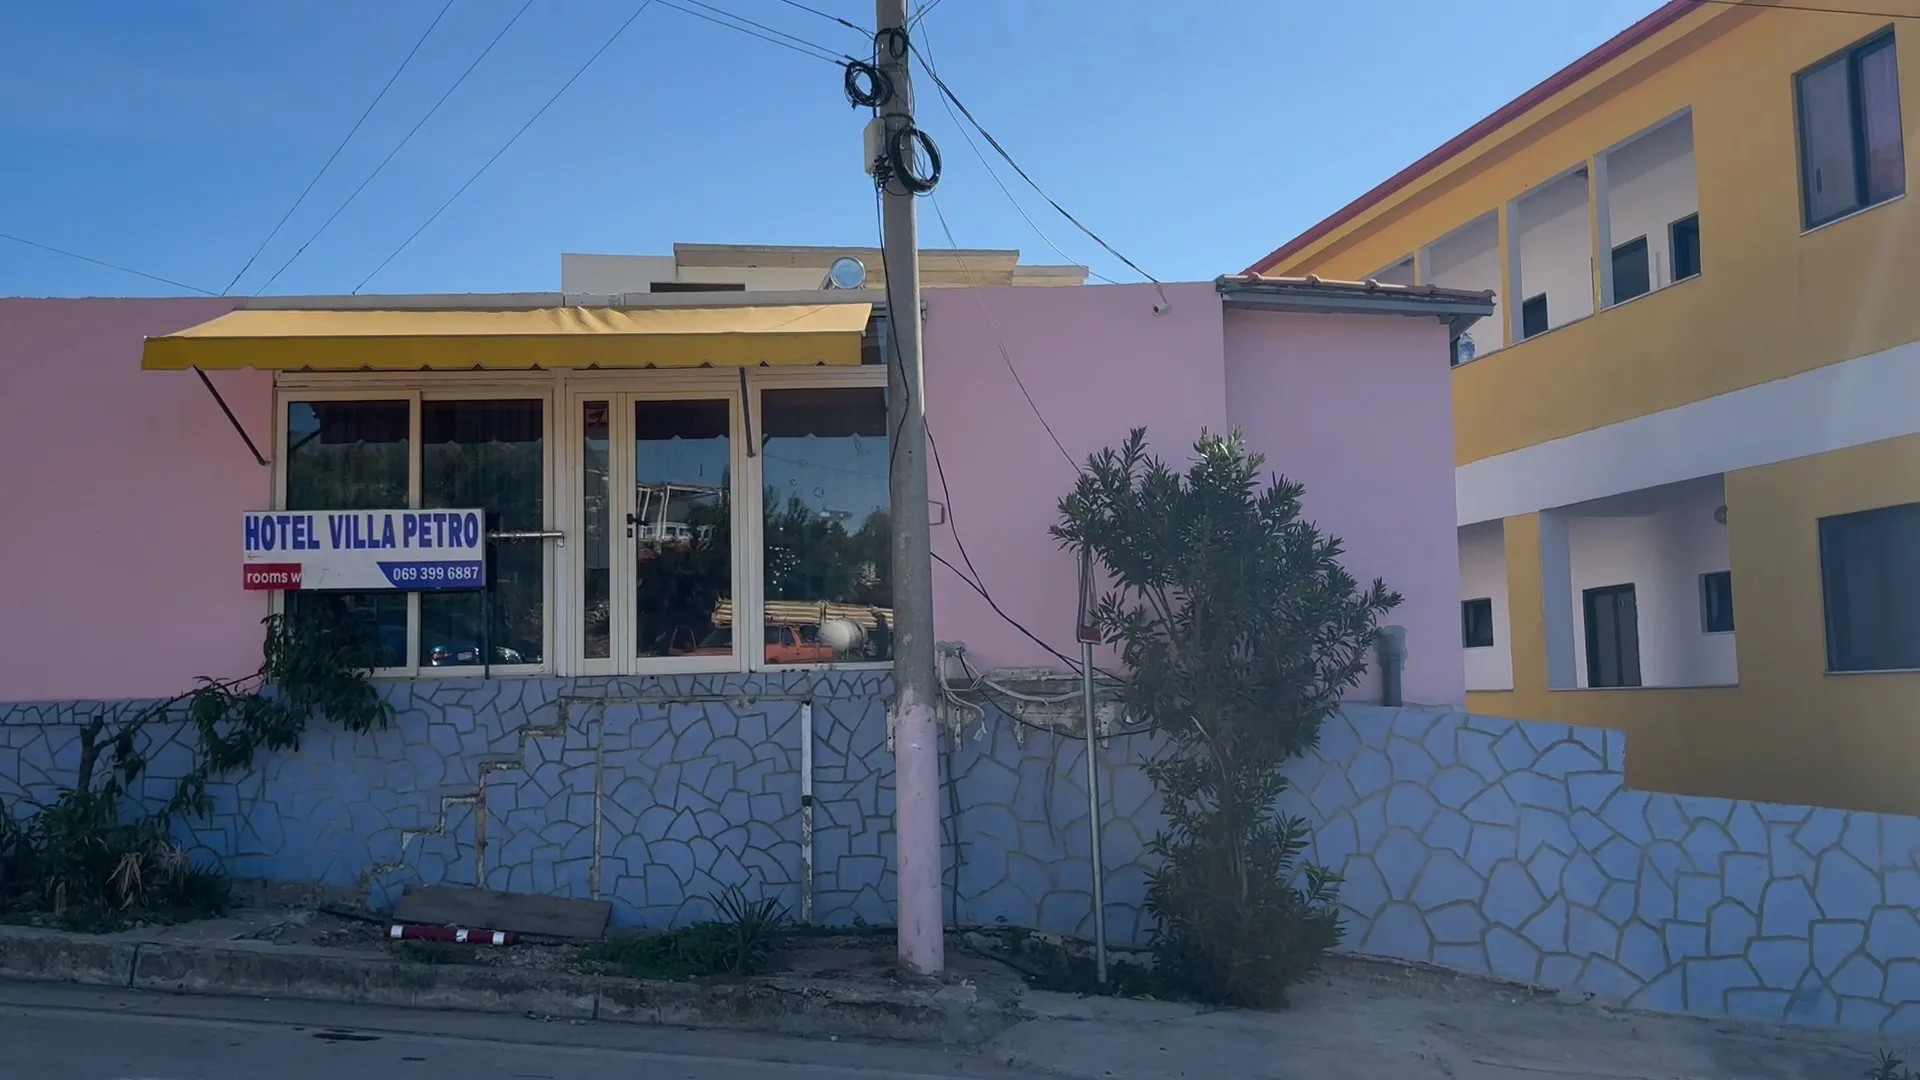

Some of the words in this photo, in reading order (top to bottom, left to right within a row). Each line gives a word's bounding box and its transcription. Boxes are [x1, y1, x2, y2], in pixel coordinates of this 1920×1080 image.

[245, 514, 320, 551] HOTEL
[328, 513, 396, 549] VILLA
[403, 512, 479, 548] PETRO
[247, 572, 288, 584] rooms
[393, 567, 417, 580] 069
[420, 567, 444, 580] 399
[447, 566, 479, 579] 6887
